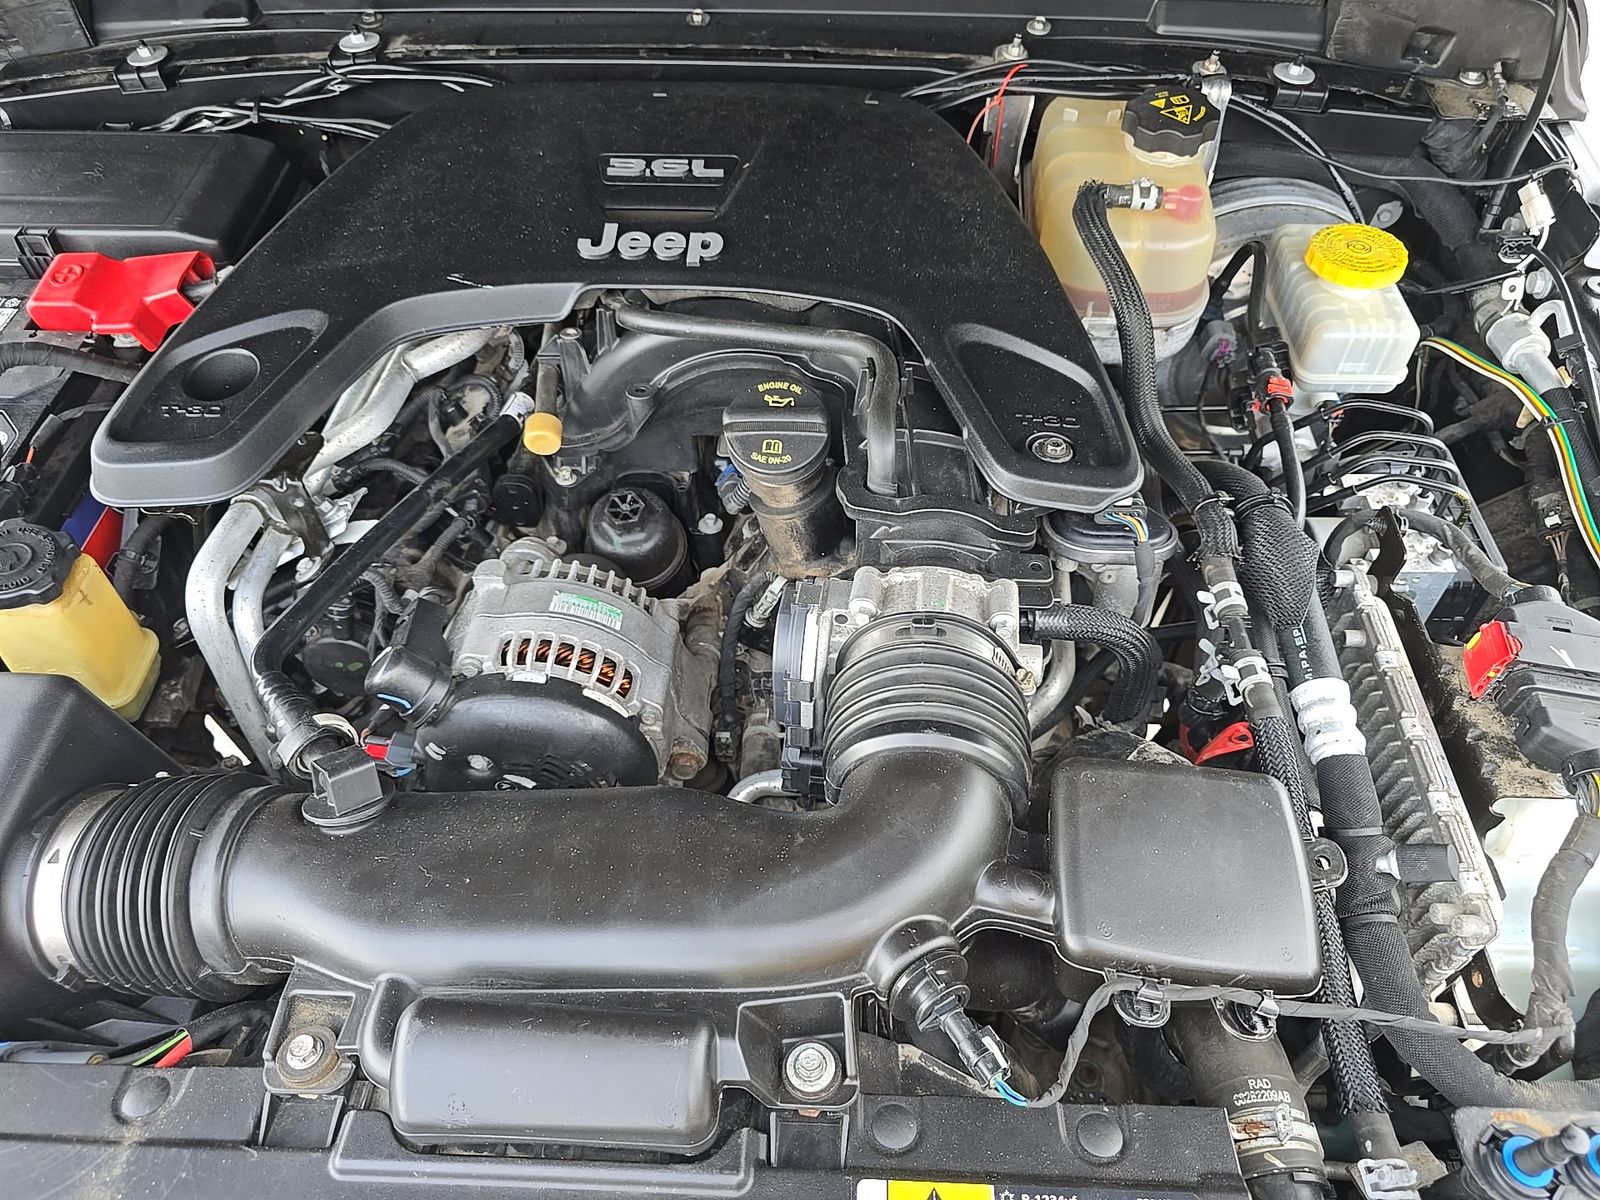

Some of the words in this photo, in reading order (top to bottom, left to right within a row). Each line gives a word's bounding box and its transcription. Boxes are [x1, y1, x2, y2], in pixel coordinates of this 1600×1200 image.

[606, 158, 725, 178] 3.6L
[577, 222, 724, 267] Jeep
[757, 381, 790, 393] ENGINE
[789, 383, 803, 395] OIL
[750, 451, 768, 464] SAE
[767, 454, 792, 465] 0W-20
[1247, 1078, 1272, 1090] RAD
